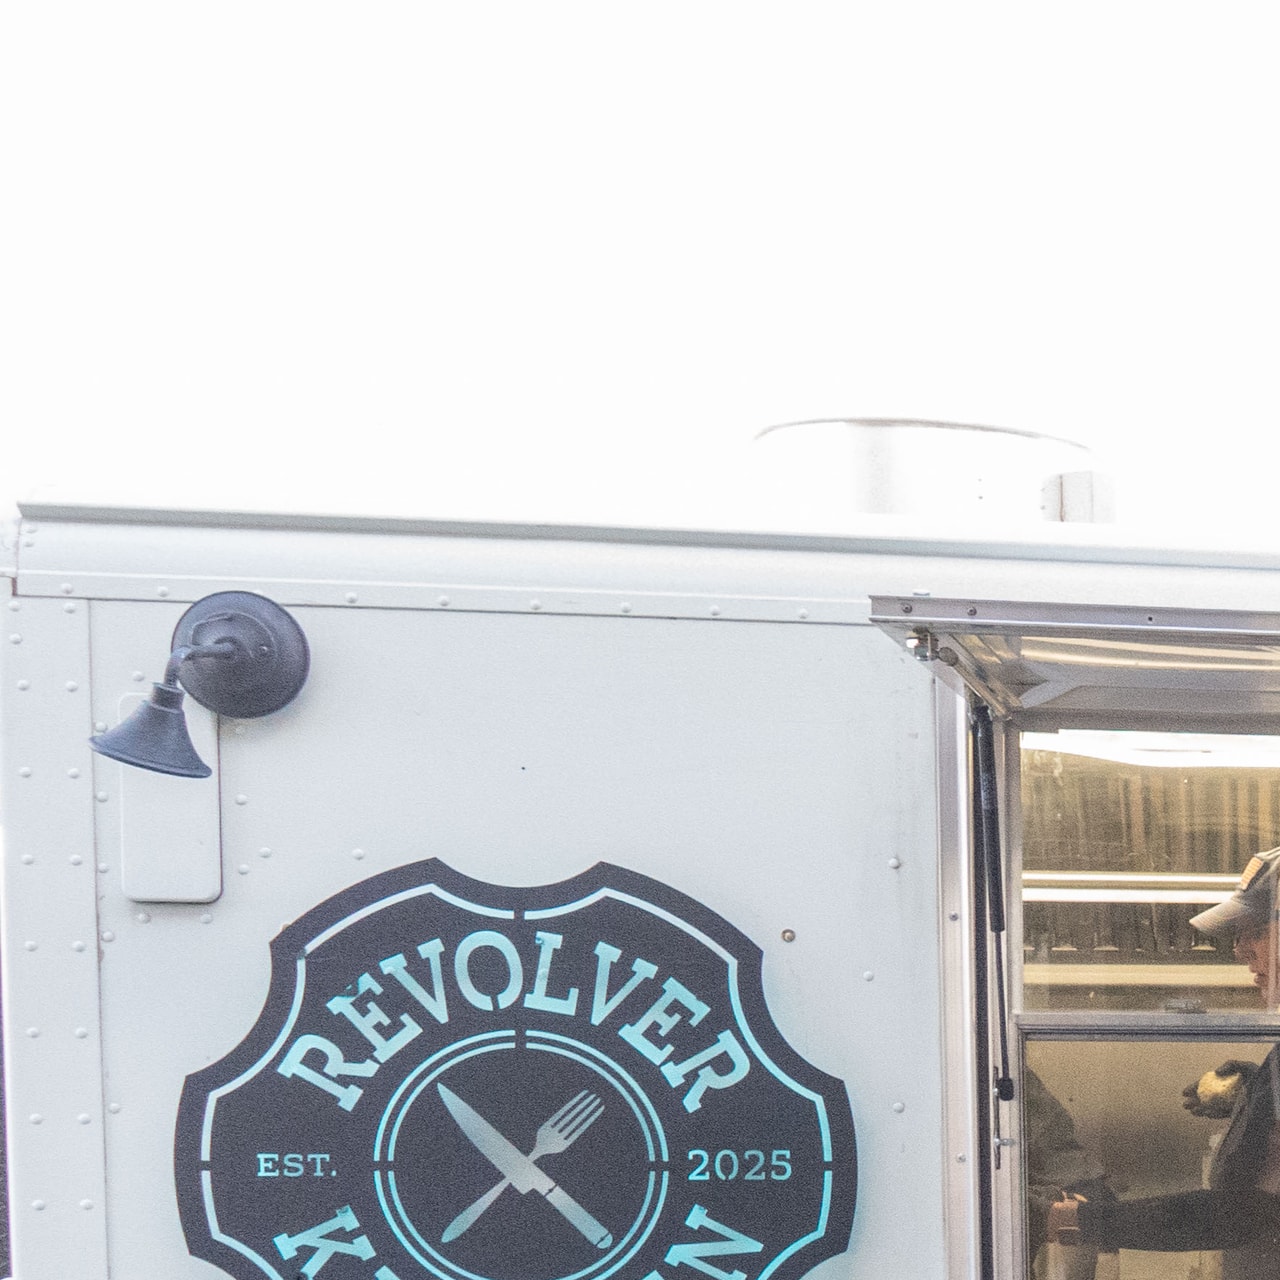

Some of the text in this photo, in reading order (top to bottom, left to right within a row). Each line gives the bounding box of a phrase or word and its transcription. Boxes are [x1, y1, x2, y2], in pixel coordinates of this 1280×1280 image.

[277, 929, 750, 1113] REVOLVER
[256, 1149, 793, 1181] EST. 2025
